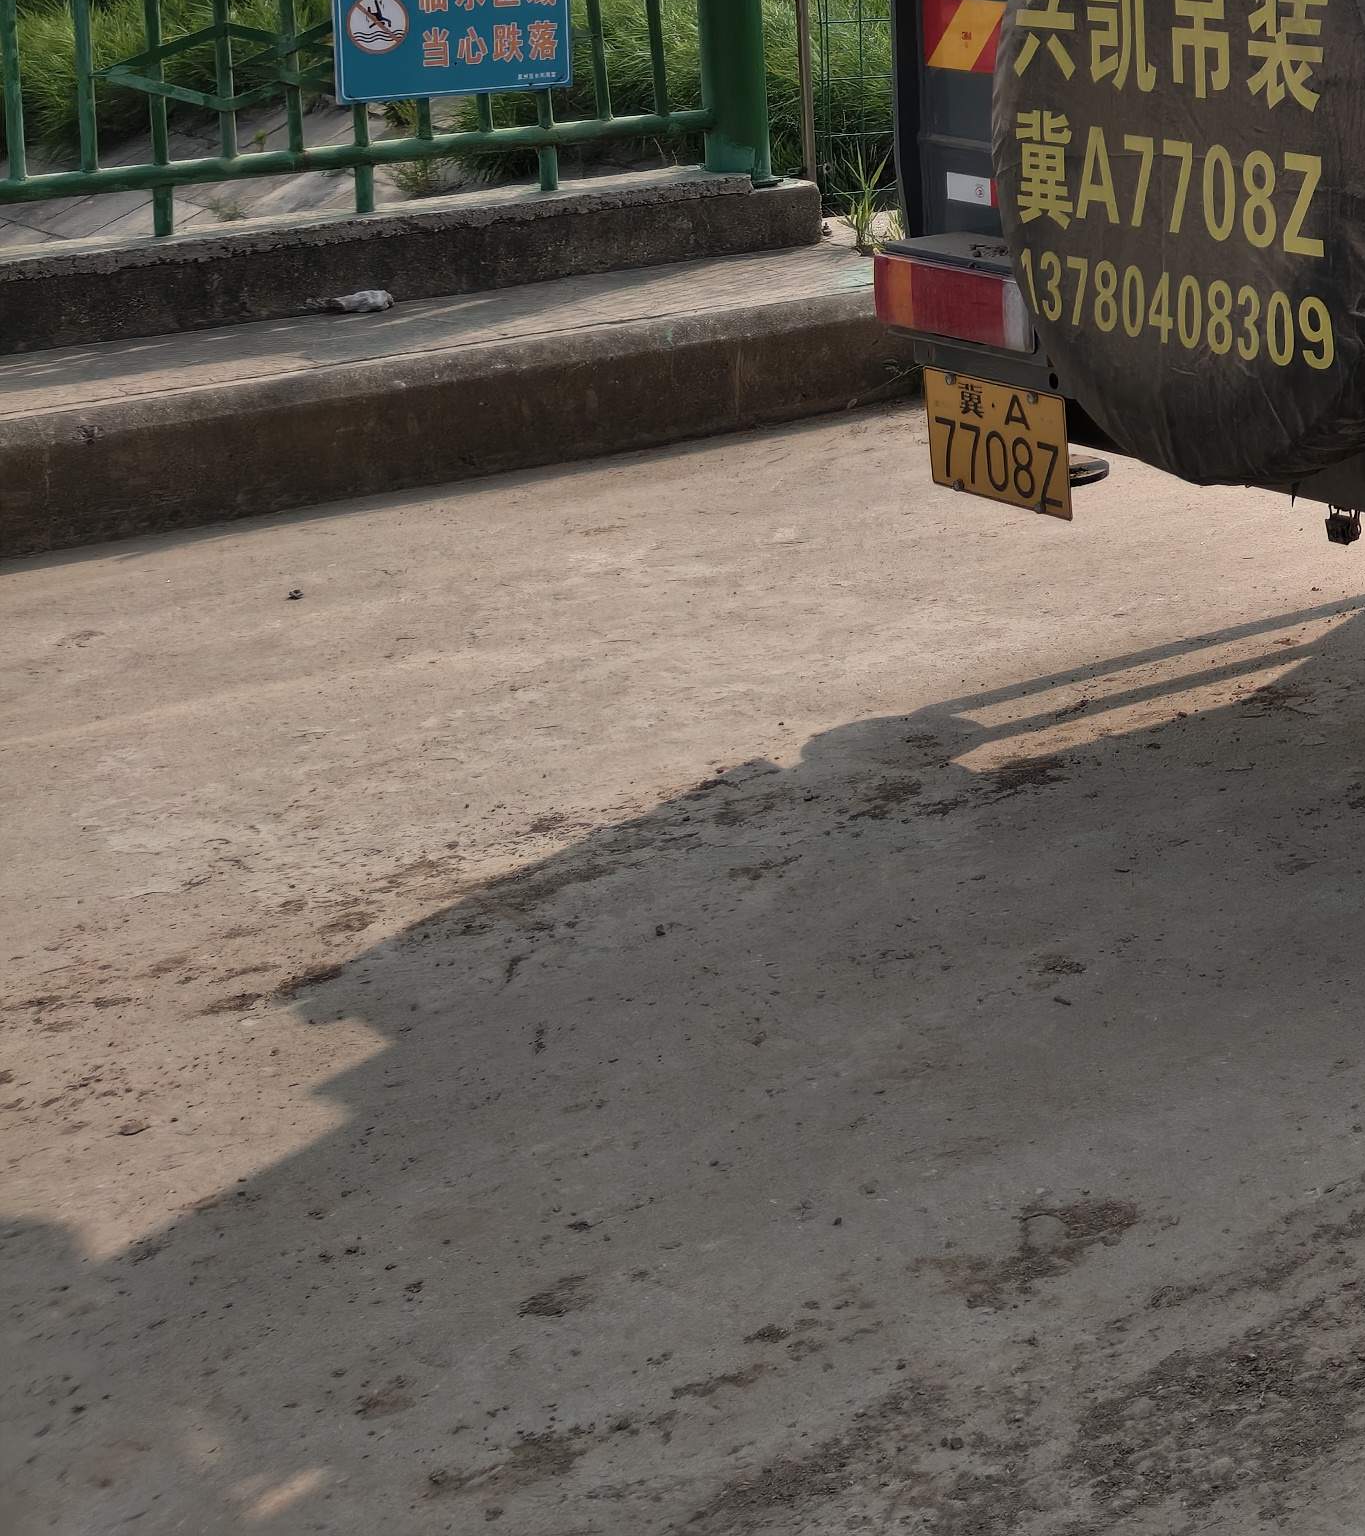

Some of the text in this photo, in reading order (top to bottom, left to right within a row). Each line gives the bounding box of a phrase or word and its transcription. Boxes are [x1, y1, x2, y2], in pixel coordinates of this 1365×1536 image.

[422, 20, 559, 68] 当心跌落
[1016, 109, 1326, 258] 冀A7708Z
[1020, 246, 1336, 371] 13780408309
[935, 415, 1064, 514] 7708Z
